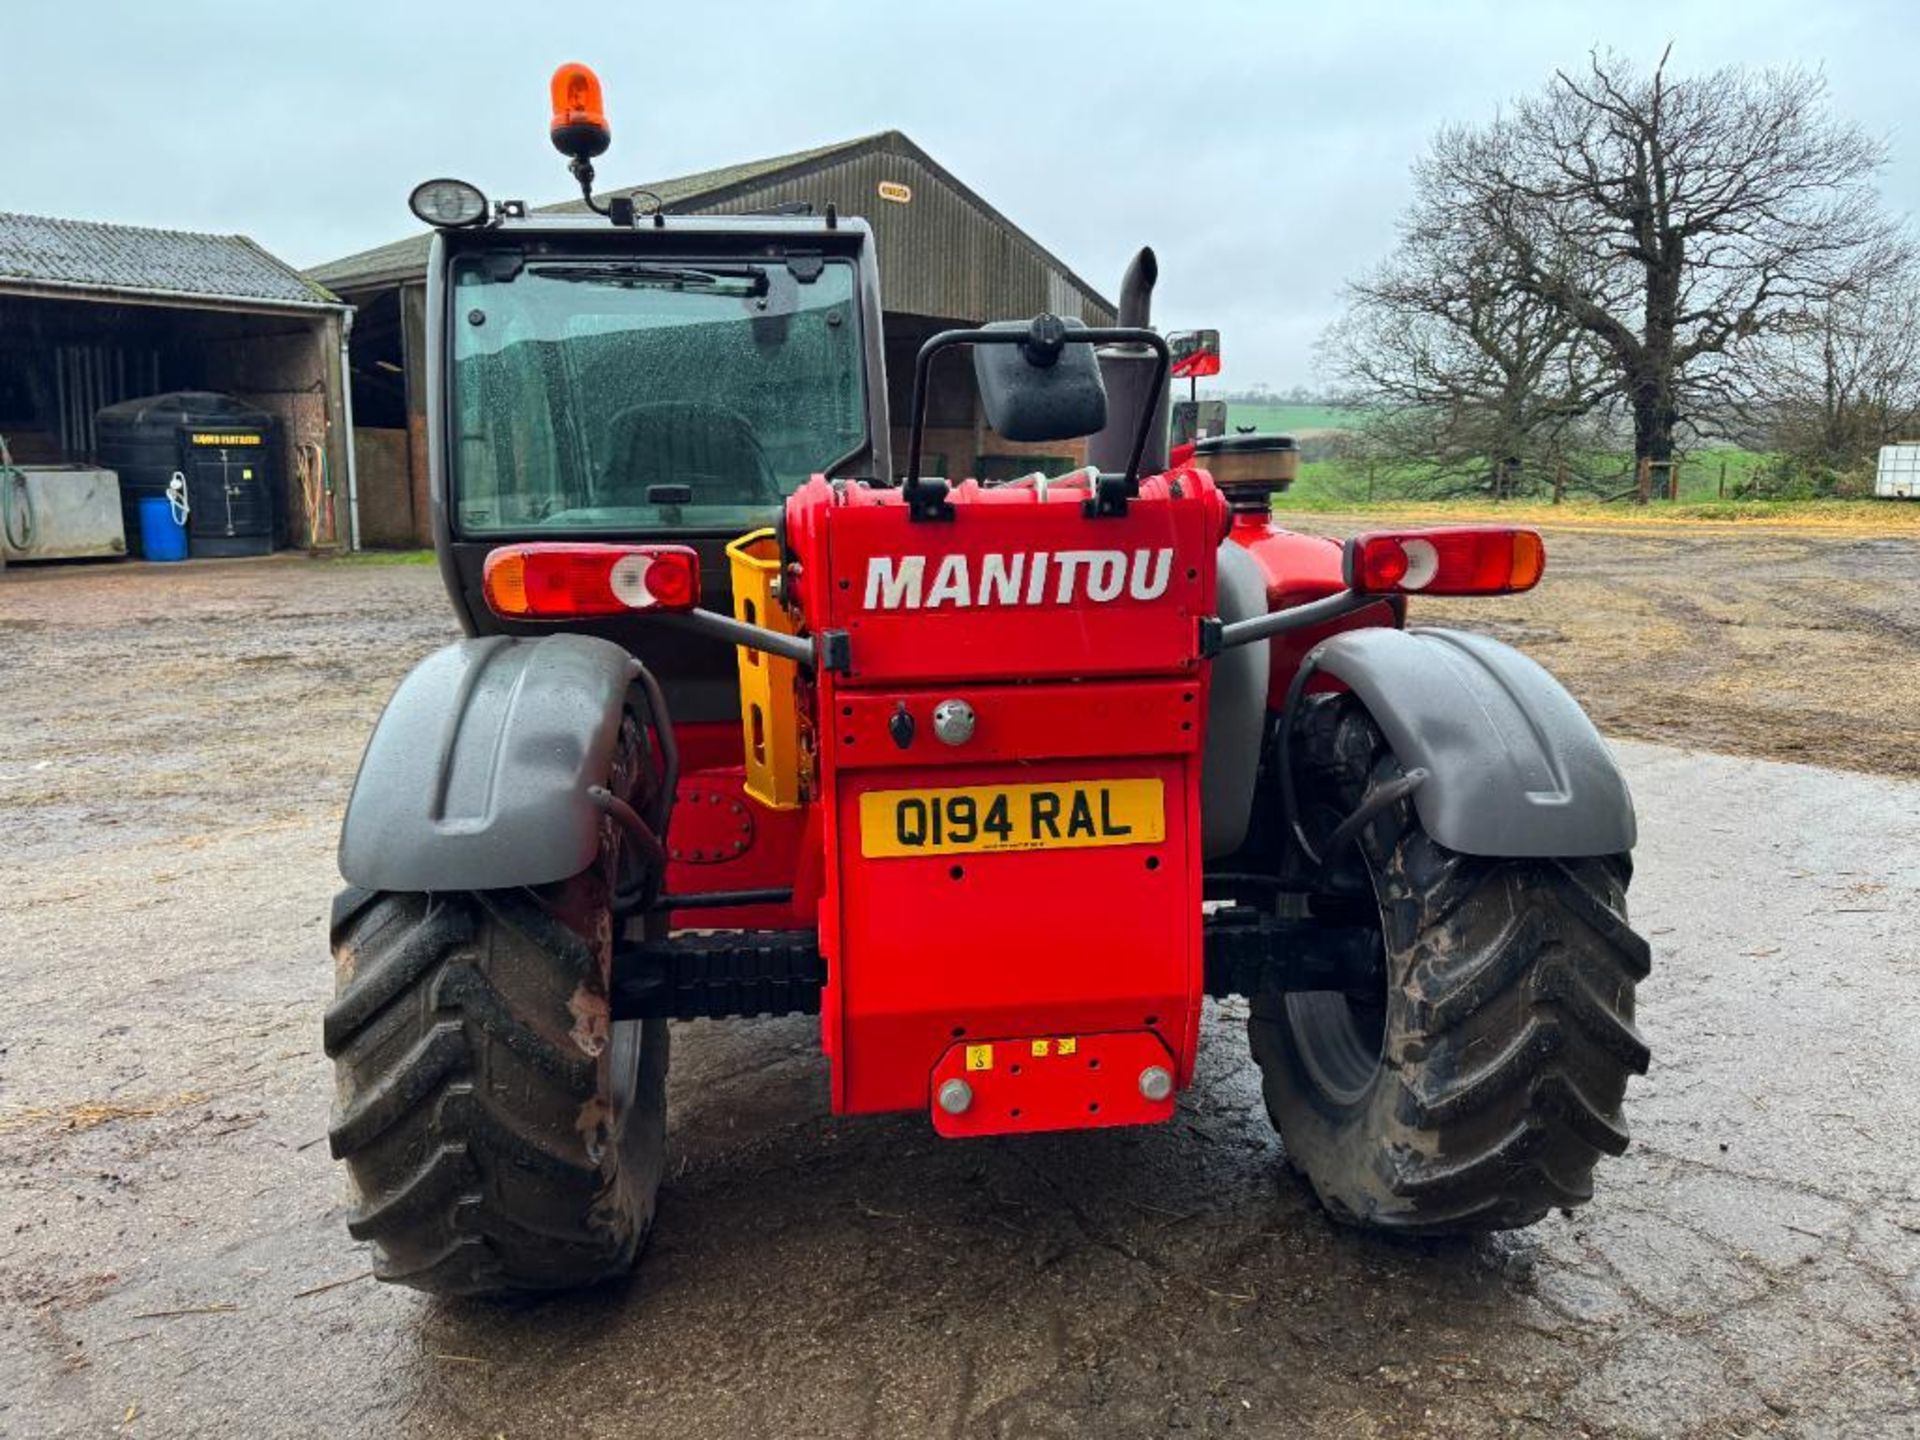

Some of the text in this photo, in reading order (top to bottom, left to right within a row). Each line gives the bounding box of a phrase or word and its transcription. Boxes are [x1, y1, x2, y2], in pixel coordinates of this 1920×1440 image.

[864, 548, 1173, 609] MANITOU
[897, 789, 1131, 846] Q194 RAL
